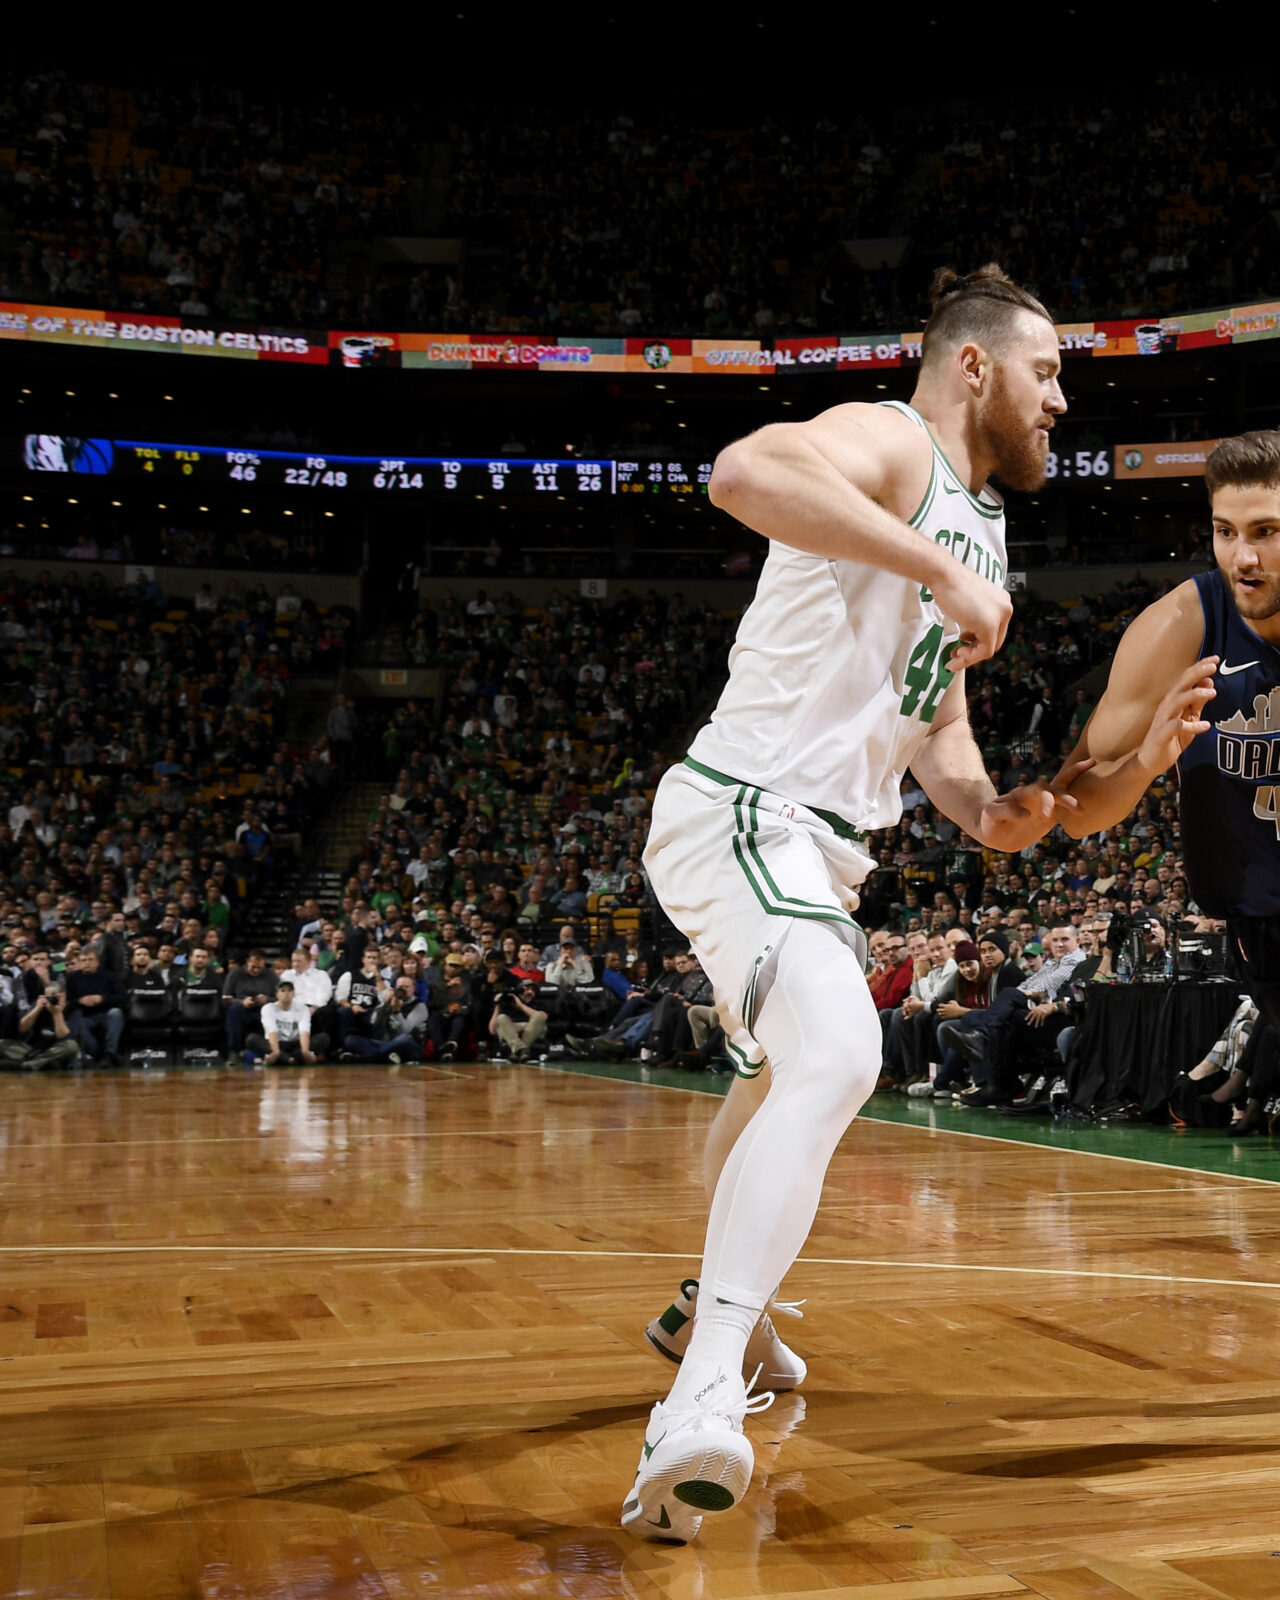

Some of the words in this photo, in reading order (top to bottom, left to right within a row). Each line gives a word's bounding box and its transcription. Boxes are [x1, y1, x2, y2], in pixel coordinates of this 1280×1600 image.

[32, 316, 67, 333] OF
[69, 318, 117, 338] THE
[119, 323, 214, 347] BOSTON
[218, 332, 309, 354] CELTICS
[519, 346, 592, 364] DONUTS
[705, 350, 796, 366] OFFICIAL
[798, 345, 872, 364] COFFEE
[875, 344, 901, 360] OF
[135, 447, 161, 459] TOL
[175, 450, 200, 461] FLS
[226, 451, 261, 465] FG%
[306, 457, 326, 470] FG
[380, 460, 405, 473] 3PT
[441, 461, 462, 473] TO
[488, 462, 510, 474] STL
[532, 463, 559, 475] AST
[576, 463, 602, 475] REB
[618, 462, 639, 471] MEM
[1155, 452, 1207, 465] OFFICIAL
[143, 461, 154, 472] 4
[229, 465, 256, 481] 46
[284, 468, 348, 487] 22/48
[373, 473, 423, 490] 6/14
[444, 474, 457, 489] 5
[492, 475, 505, 490] 5
[535, 476, 558, 491] 11
[578, 476, 601, 491] 26
[617, 472, 632, 481] NY
[667, 473, 688, 482] CHA
[589, 581, 598, 595] 8
[1009, 575, 1017, 589] 8
